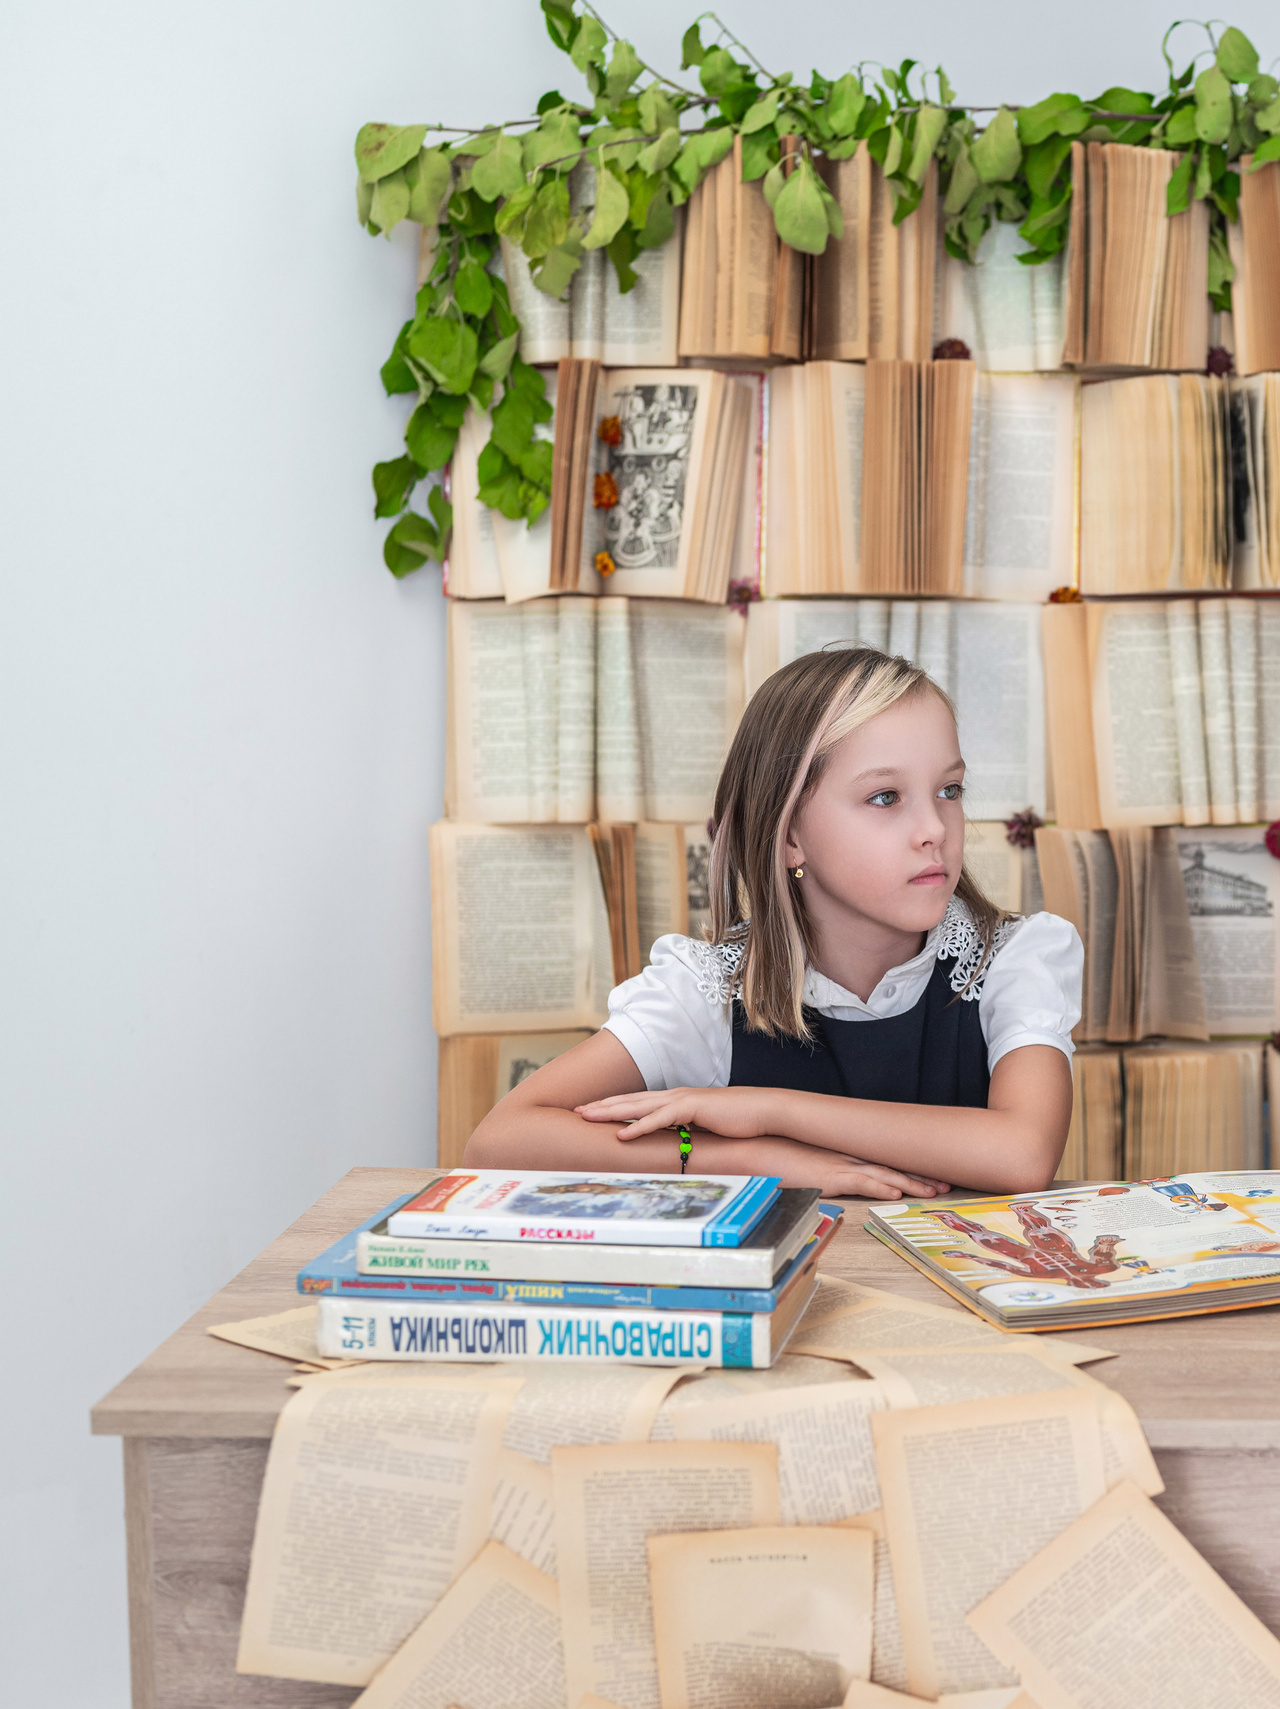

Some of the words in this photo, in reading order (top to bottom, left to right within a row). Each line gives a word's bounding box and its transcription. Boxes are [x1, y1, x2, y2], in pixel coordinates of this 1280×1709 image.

[519, 1227, 595, 1241] РАССКАЗЫ
[368, 1253, 423, 1270] ЖИВОЙ
[427, 1257, 461, 1270] МИР
[464, 1259, 491, 1272] РЕК
[506, 1284, 564, 1299] МИША
[390, 1315, 528, 1354] ШКОЛЬНИКА
[537, 1319, 712, 1359] СПРАВОЧНИК
